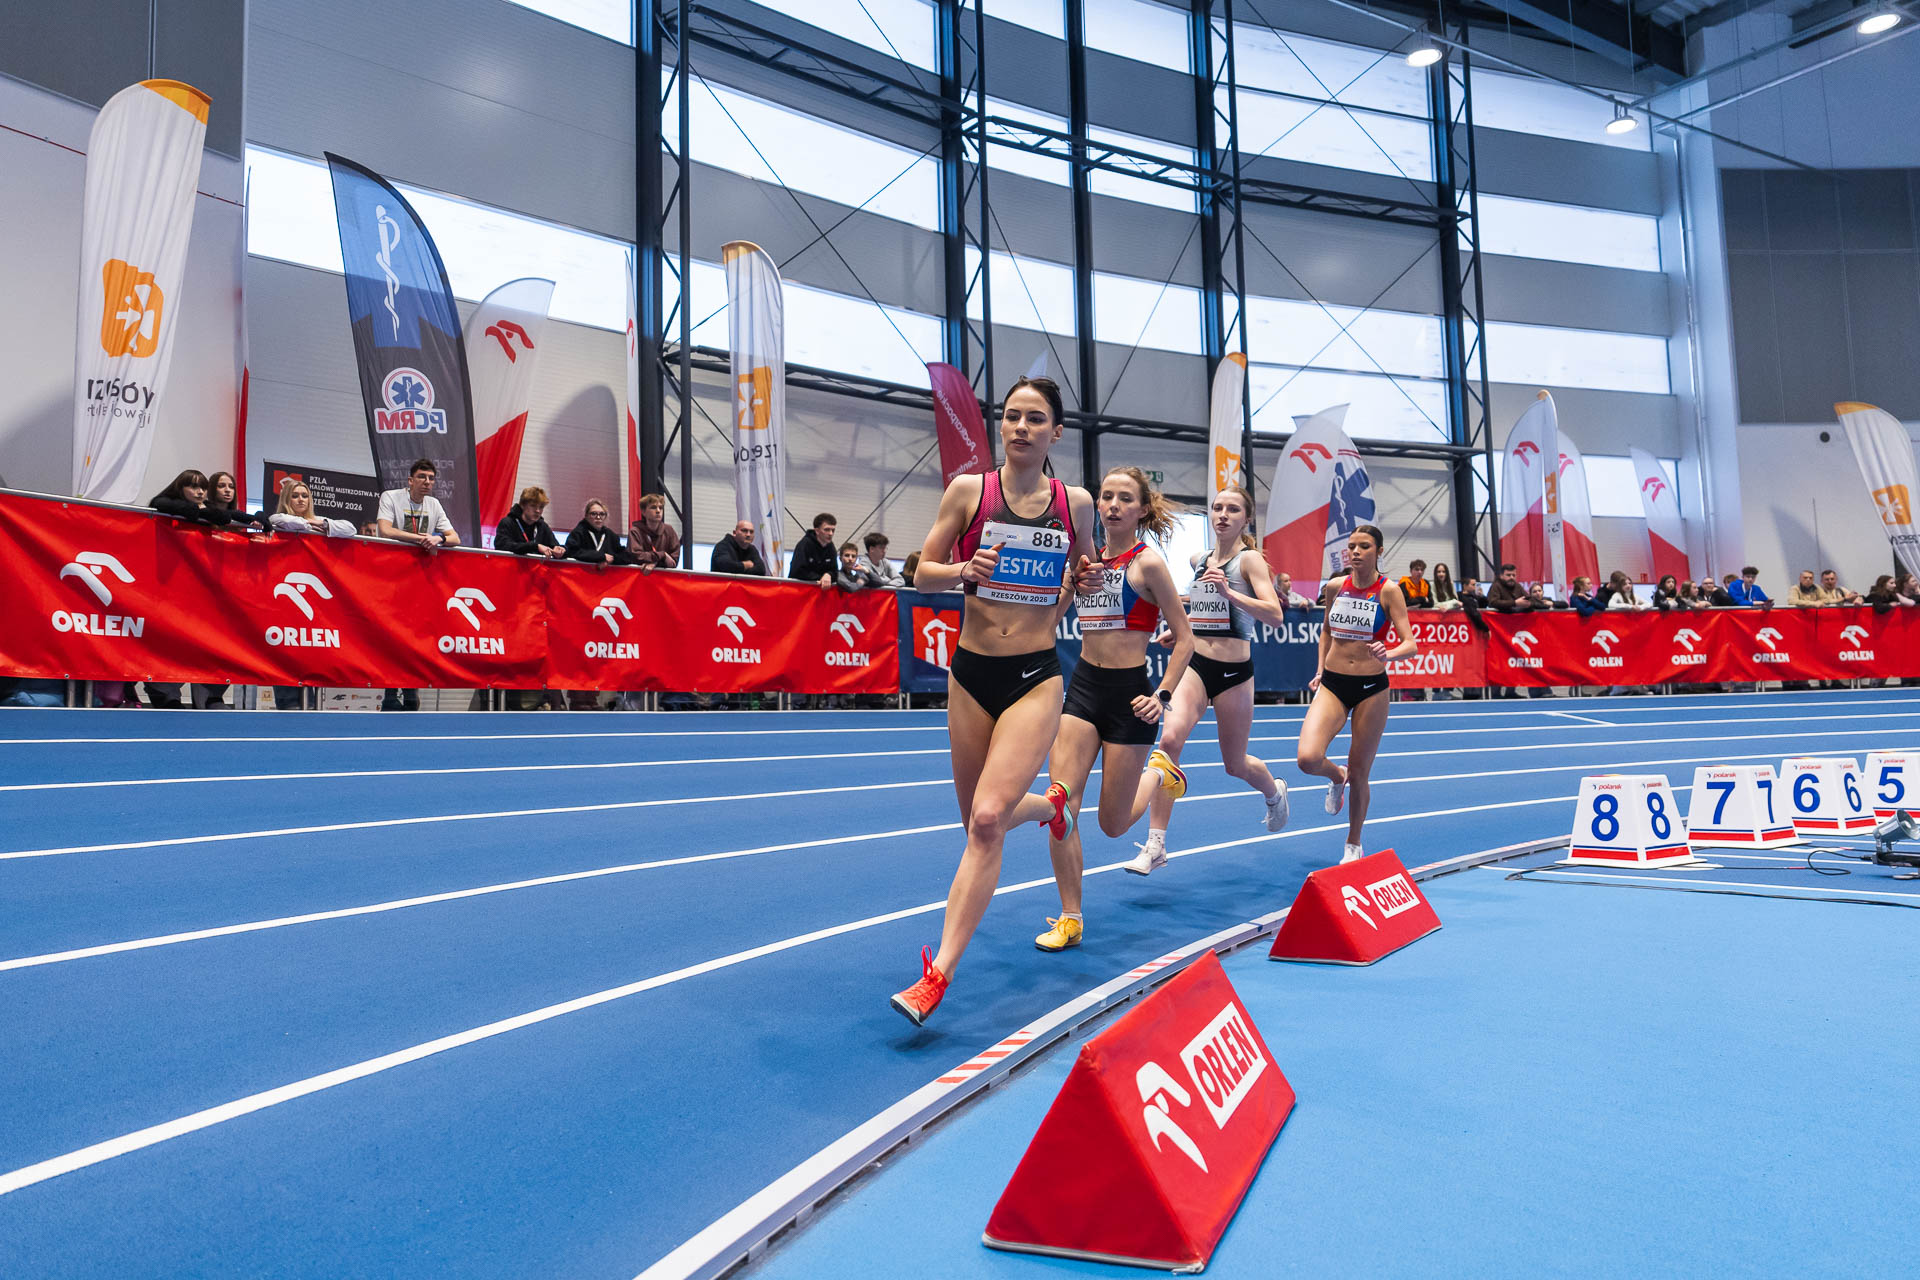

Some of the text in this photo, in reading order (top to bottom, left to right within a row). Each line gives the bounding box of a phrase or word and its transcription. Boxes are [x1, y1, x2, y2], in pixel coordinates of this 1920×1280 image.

[310, 476, 326, 484] PZLA
[310, 484, 334, 492] HALOWE
[336, 488, 372, 498] MISTRZOSTWA
[325, 492, 335, 500] U20
[314, 498, 362, 511] ZESZÓW 2026
[1032, 532, 1062, 549] 881
[997, 556, 1054, 578] ESTKA
[1104, 573, 1122, 584] 49
[991, 591, 1028, 602] RZESZÓW
[1352, 601, 1375, 612] 1151
[52, 610, 144, 637] ORLEN
[1330, 613, 1371, 628] SZŁAPKA
[266, 626, 340, 648] ORLEN
[1386, 621, 1469, 643] 6.2.2026
[438, 636, 504, 654] ORLEN
[584, 642, 640, 660] ORLEN
[712, 647, 761, 664] ORLEN
[825, 651, 870, 666] ORLEN
[1385, 650, 1454, 675] ZESZÓW
[1508, 657, 1543, 668] ORLEN
[1589, 656, 1623, 668] ORLEN
[1672, 654, 1707, 665] ORLEN
[1752, 652, 1790, 663] ORLEN
[1839, 650, 1874, 661] ORLEN
[1793, 773, 1820, 813] 6
[1844, 772, 1862, 812] 6
[1878, 767, 1905, 804] 5
[1706, 782, 1736, 824] 7
[1757, 780, 1775, 823] 7
[1591, 794, 1619, 841] 8
[1647, 792, 1671, 840] 8
[1372, 879, 1415, 912] ORLEN
[1192, 1015, 1258, 1109] ORLEN
